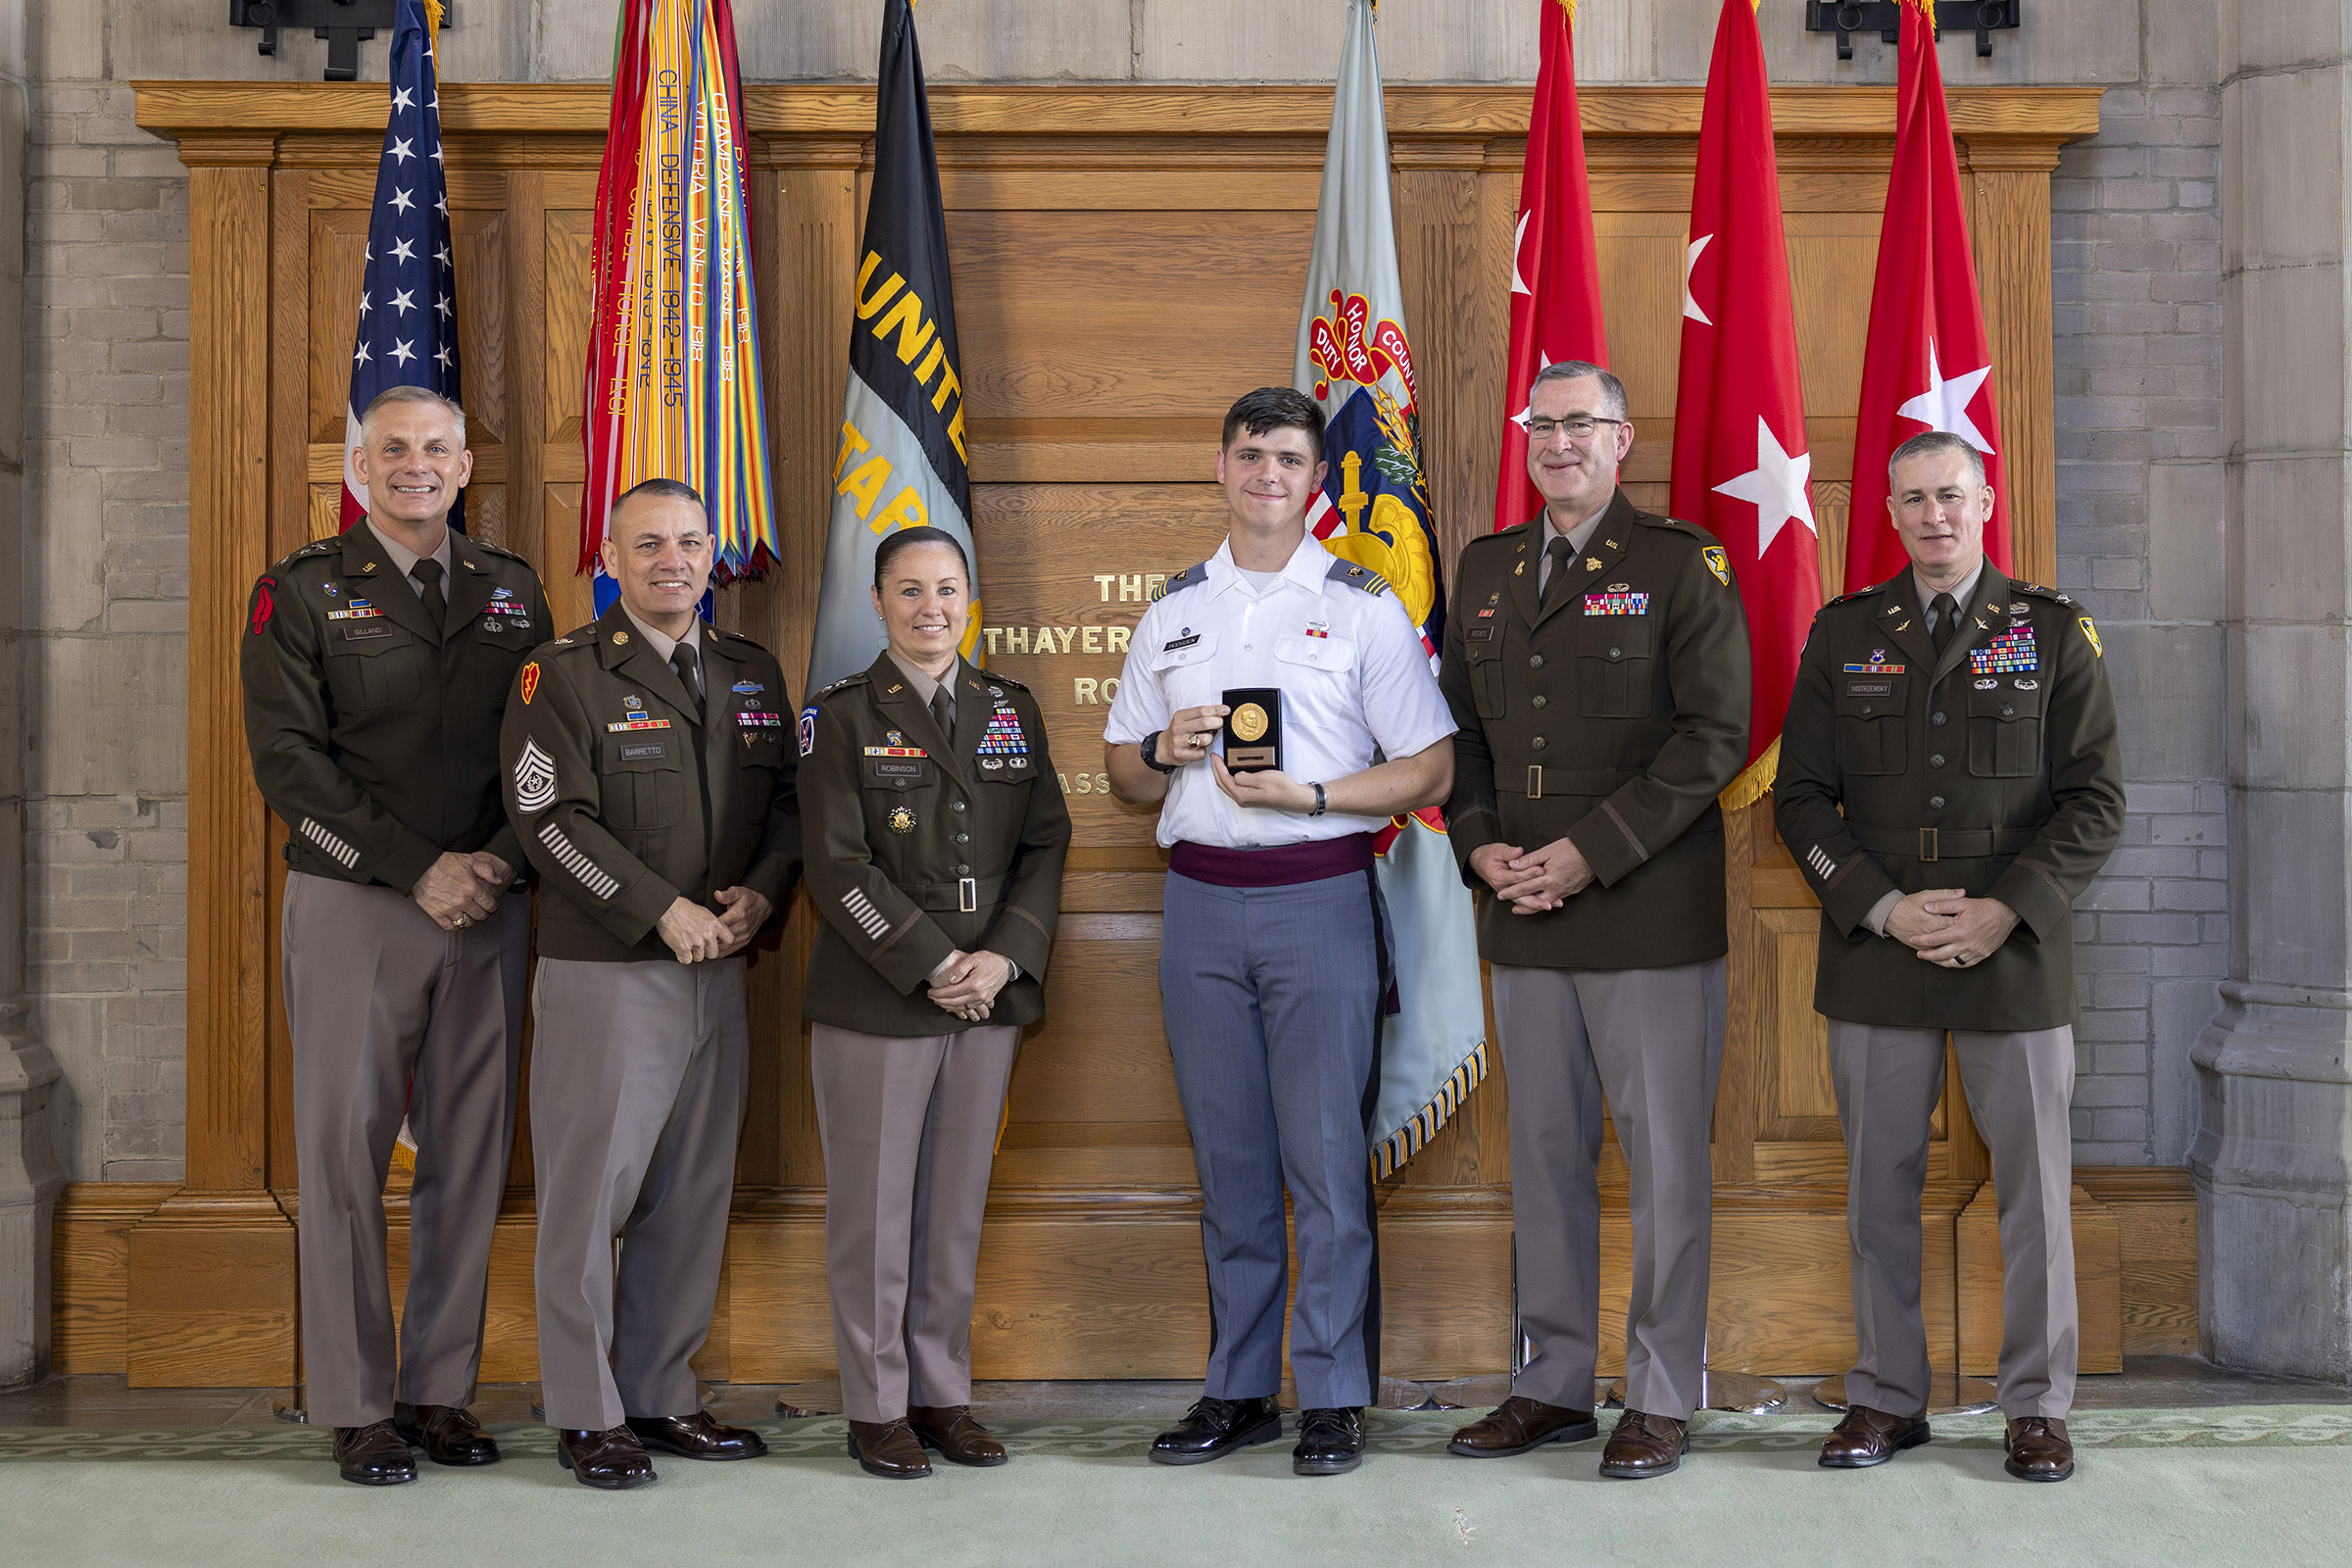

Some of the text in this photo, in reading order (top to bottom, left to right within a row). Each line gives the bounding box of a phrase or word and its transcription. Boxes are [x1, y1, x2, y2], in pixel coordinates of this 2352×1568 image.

[659, 70, 679, 134] CHINA
[661, 154, 682, 272] DEFENSIVE
[690, 100, 707, 362] VITTORIA VENETO 1918
[737, 308, 751, 344] 1918
[1347, 302, 1368, 372] HONOR
[721, 345, 733, 382] 1918
[1316, 327, 1341, 371] DUTY
[1094, 574, 1165, 602] THE
[354, 627, 382, 636] GILLAND
[983, 626, 1131, 655] THAYER
[625, 746, 662, 757] BARRETTO
[881, 764, 916, 773] ROBINSON
